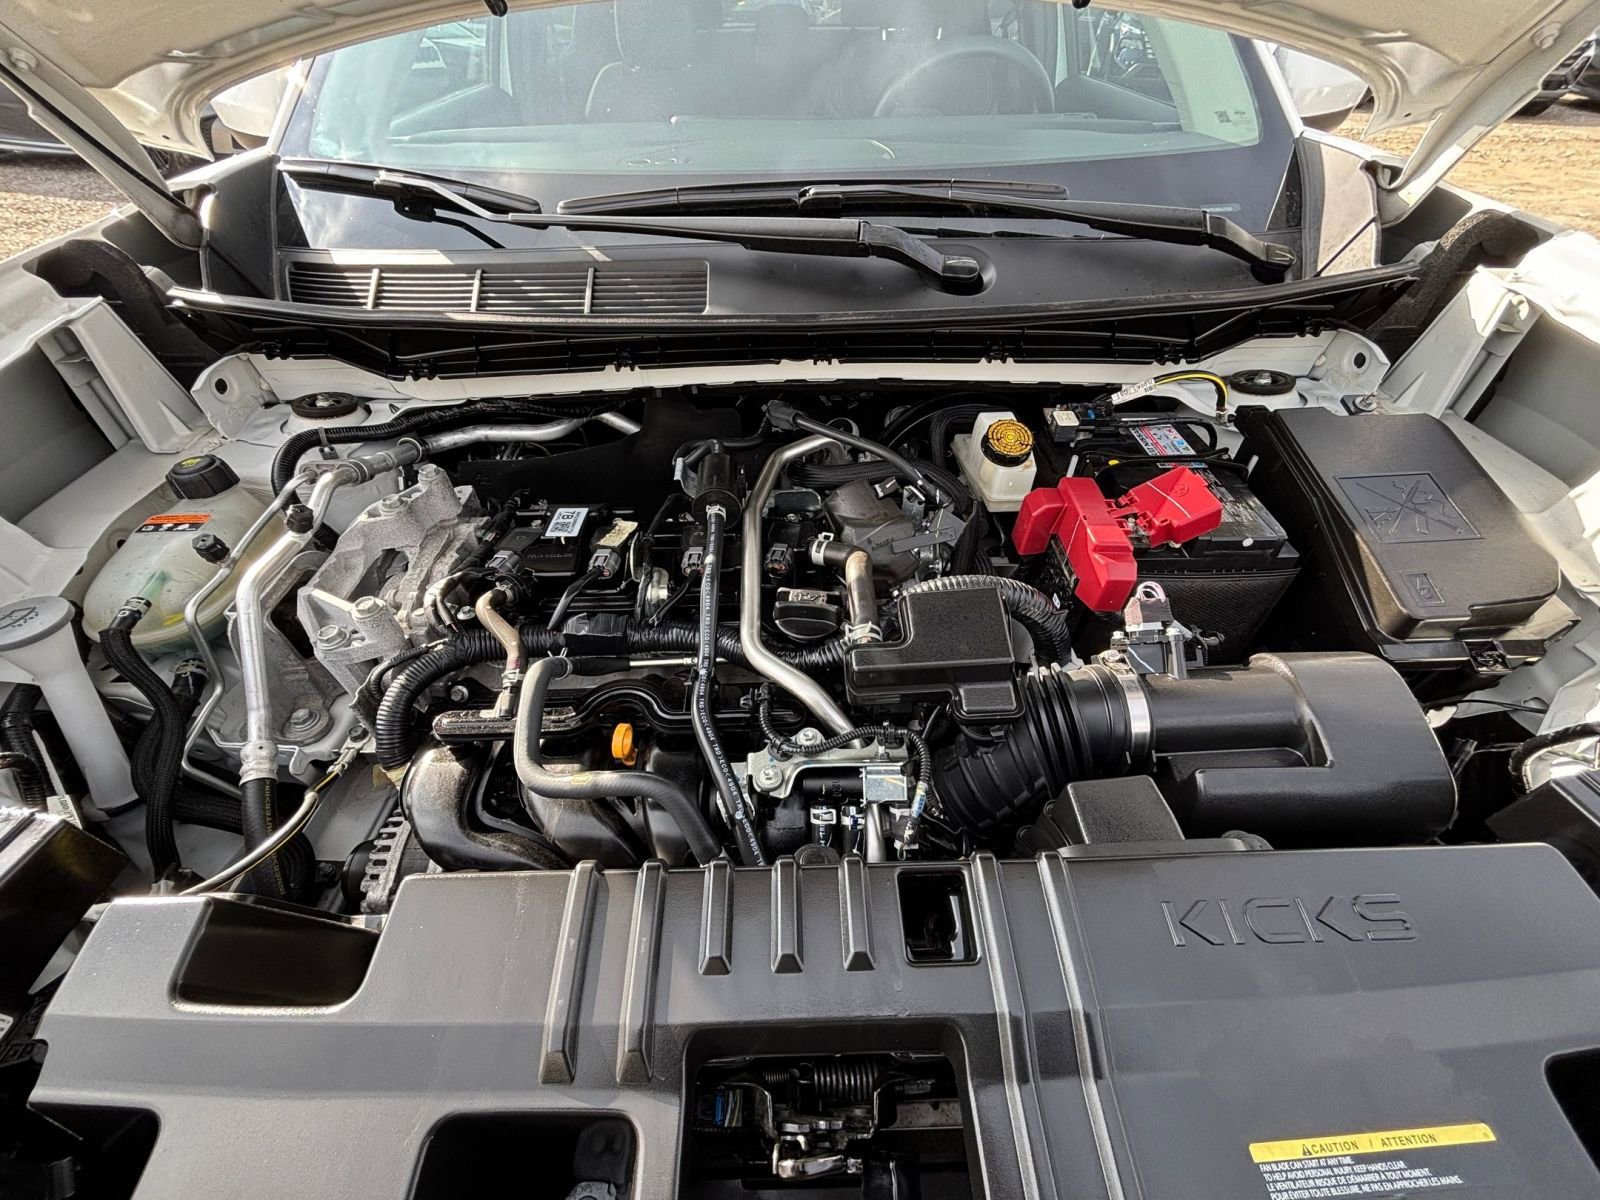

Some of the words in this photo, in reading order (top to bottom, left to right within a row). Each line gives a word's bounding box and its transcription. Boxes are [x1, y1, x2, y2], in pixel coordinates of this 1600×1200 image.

[1160, 893, 1418, 947] KICKS
[1312, 1140, 1359, 1154] CAUTION
[1382, 1133, 1438, 1148] ATTENTION
[1259, 1164, 1272, 1172] FAN
[1271, 1162, 1289, 1171] BLADE
[1289, 1161, 1302, 1170] CAN
[1302, 1159, 1320, 1168] START
[1320, 1158, 1327, 1166] AT
[1327, 1157, 1340, 1166] ANY
[1263, 1173, 1273, 1182] TO
[1273, 1172, 1288, 1181] HELP
[1288, 1170, 1306, 1179] AVOID
[1305, 1168, 1334, 1178] PERSONAL
[1353, 1164, 1367, 1173] KEEP
[1366, 1162, 1388, 1172] HANDS
[1266, 1183, 1275, 1192] LE
[1275, 1180, 1315, 1190] VENTILATEUR
[1315, 1177, 1338, 1188] RISQUE
[1337, 1176, 1347, 1185] DE
[1386, 1170, 1403, 1179] TOUT
[1270, 1192, 1289, 1200] POUR
[1310, 1188, 1331, 1197] TOUTE
[1362, 1184, 1372, 1192] NE
[1371, 1183, 1384, 1192] PAS
[1384, 1182, 1394, 1190] EN
[1394, 1178, 1429, 1190] APPROCHER
[1428, 1177, 1440, 1186] LES
